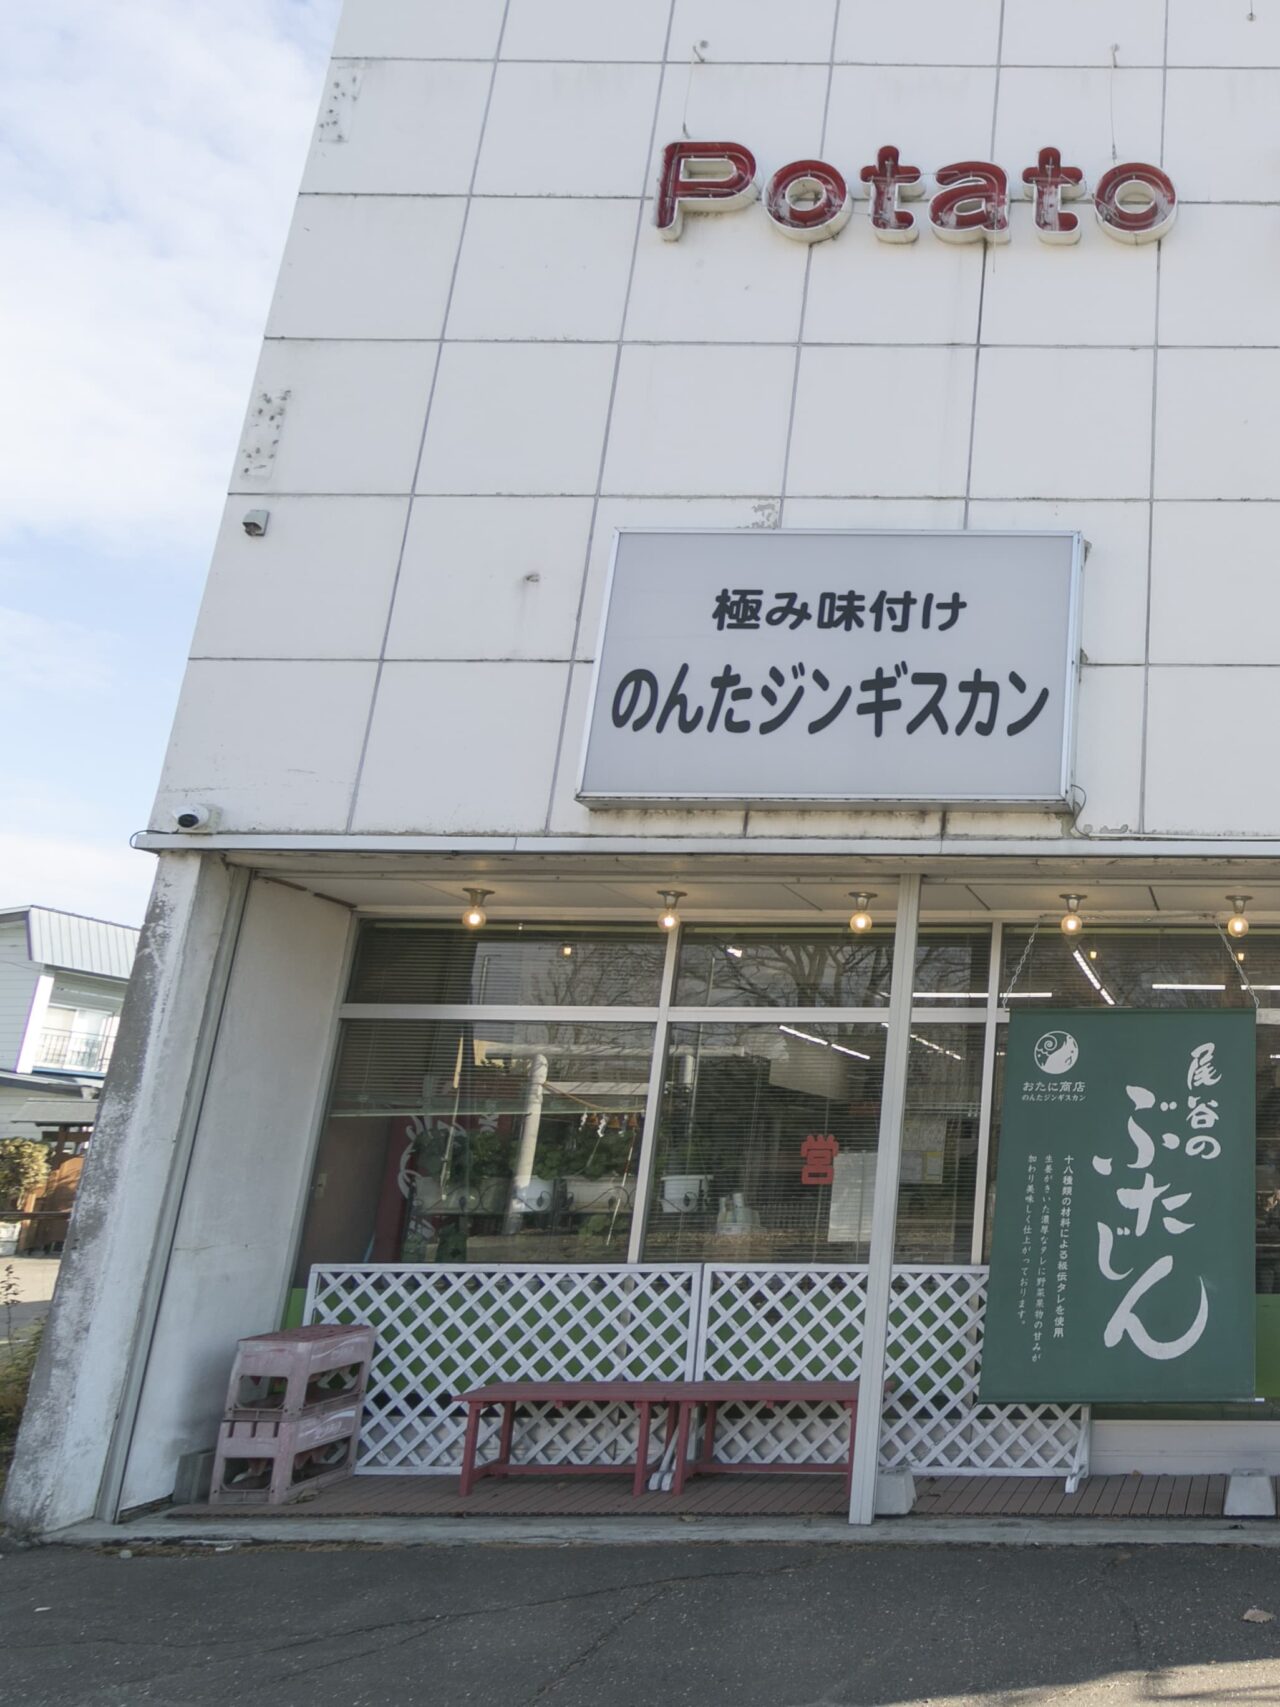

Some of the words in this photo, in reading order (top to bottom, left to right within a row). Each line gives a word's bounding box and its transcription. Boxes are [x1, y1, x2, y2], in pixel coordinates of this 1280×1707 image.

[656, 141, 1178, 246] Potato
[712, 589, 967, 632] 極み味付け
[612, 661, 1049, 738] のんたジンギスカン
[1022, 1081, 1086, 1093] おたに商店
[1185, 1042, 1222, 1159] 尾谷の
[1092, 1085, 1208, 1360] ぶたじん
